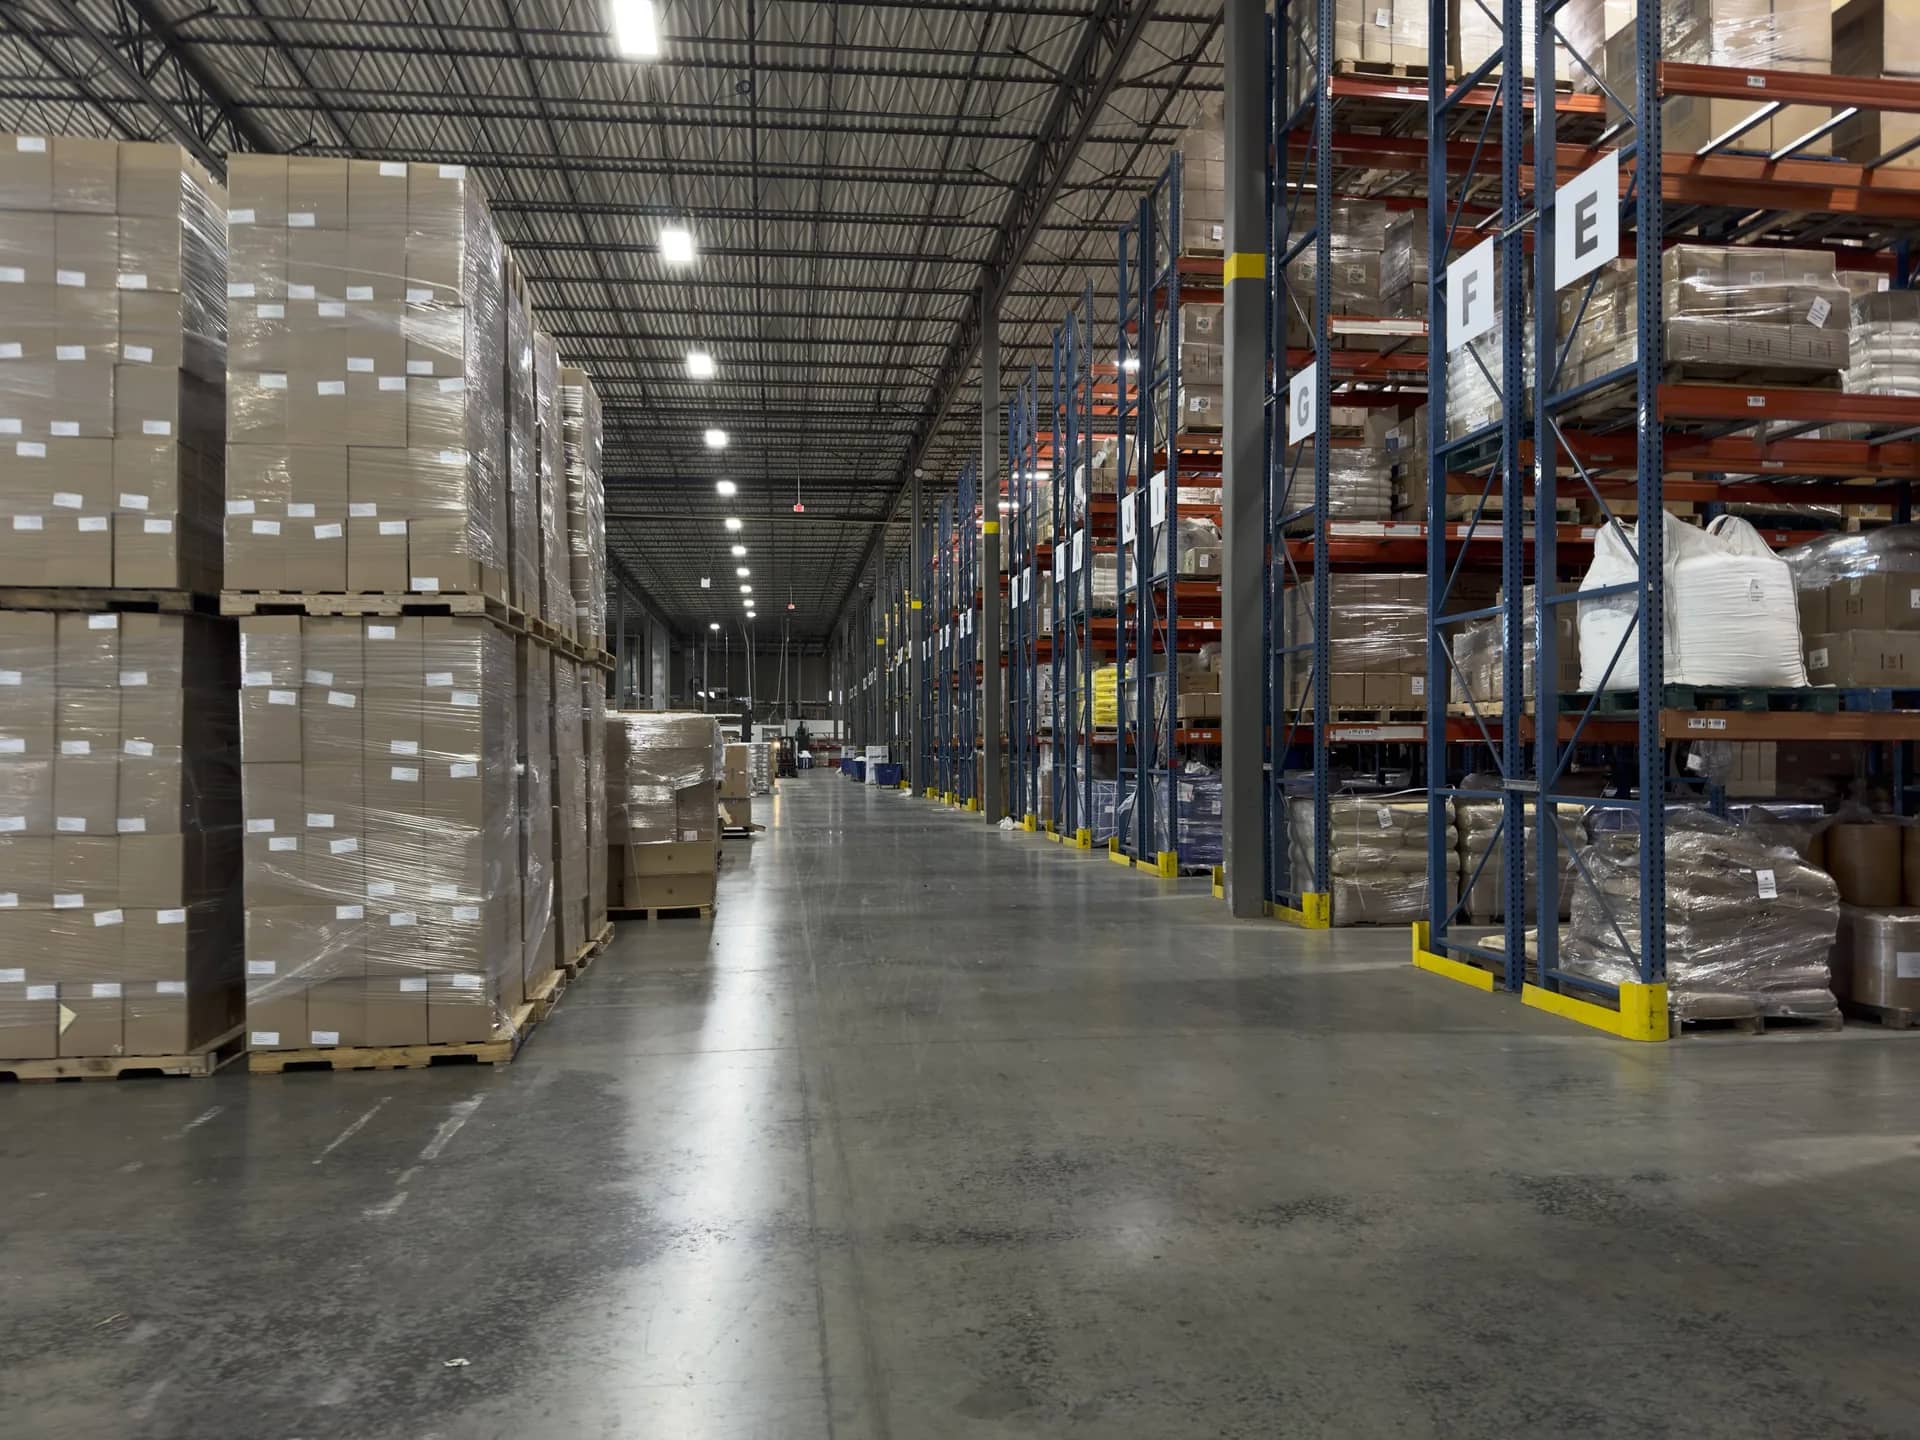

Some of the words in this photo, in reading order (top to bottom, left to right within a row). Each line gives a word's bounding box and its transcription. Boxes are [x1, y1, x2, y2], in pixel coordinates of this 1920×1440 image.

[1574, 191, 1599, 260] E
[1462, 269, 1478, 327] F
[1297, 387, 1310, 427] G
[1126, 506, 1131, 533] J
